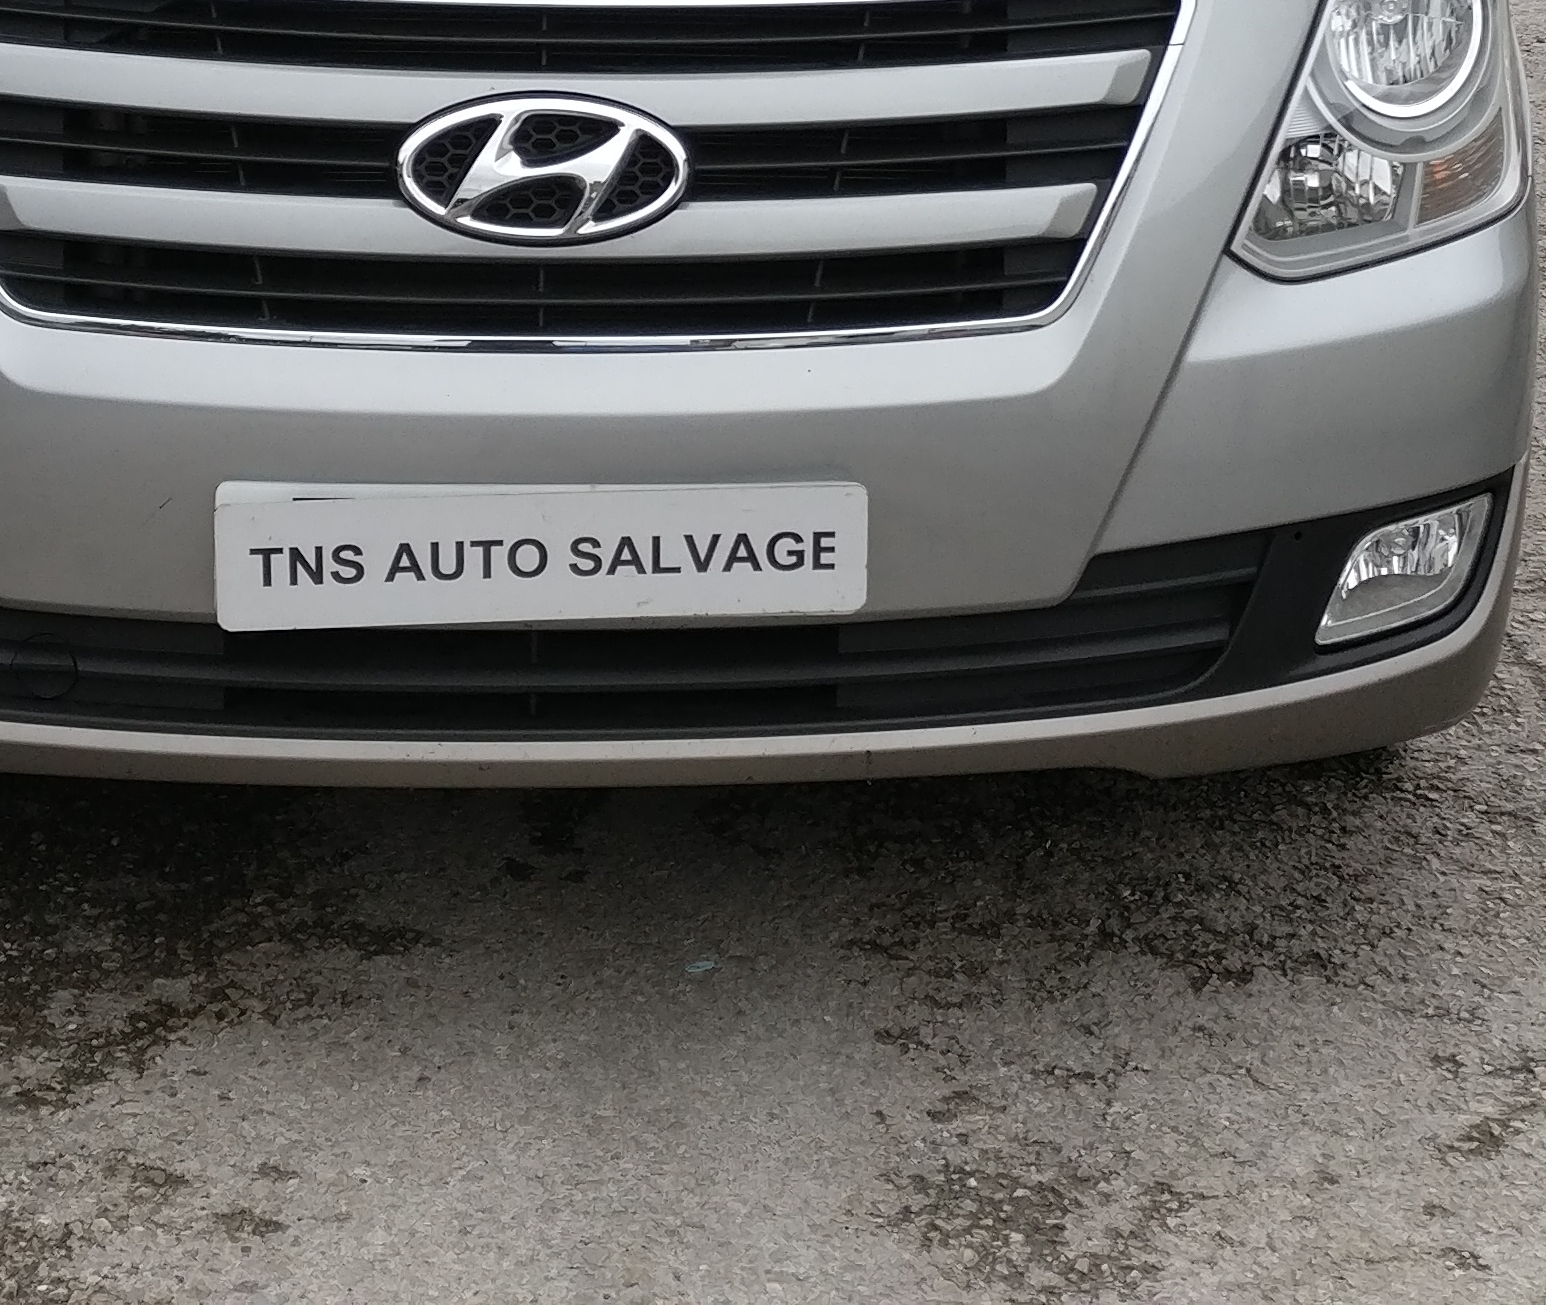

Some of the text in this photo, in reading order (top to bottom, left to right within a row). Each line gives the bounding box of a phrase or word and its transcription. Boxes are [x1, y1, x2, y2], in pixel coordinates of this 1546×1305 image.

[249, 529, 837, 588] TNS AUTO SALVAGE
